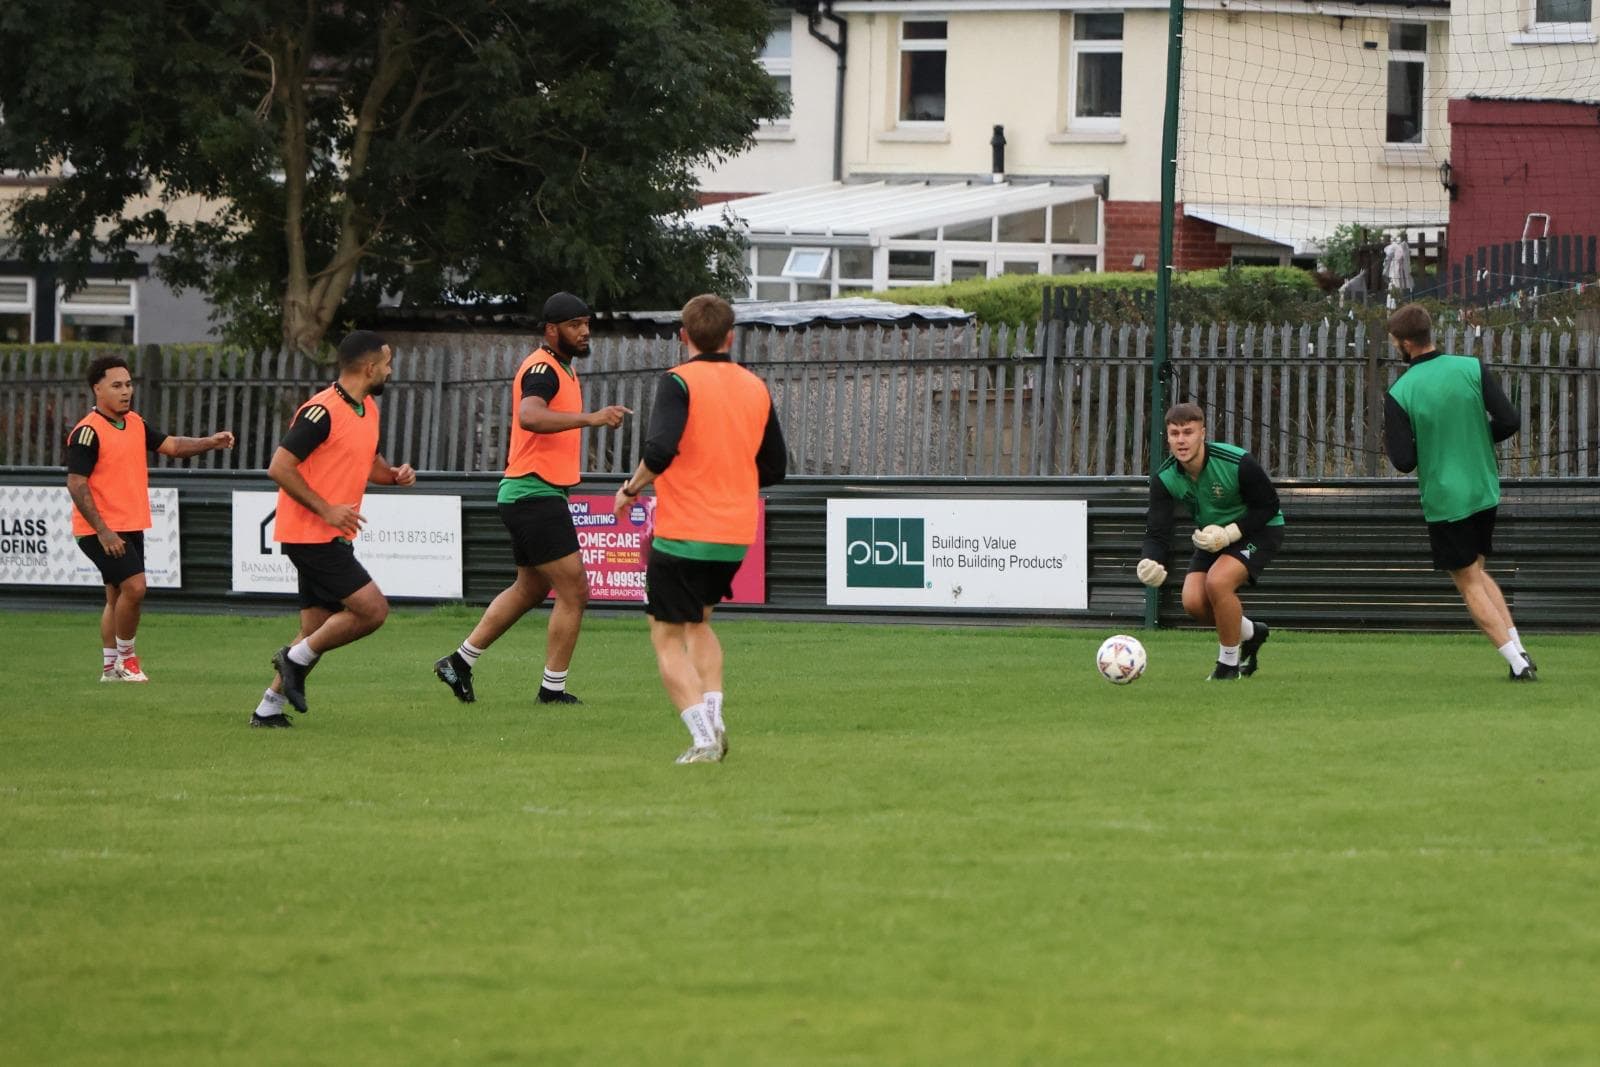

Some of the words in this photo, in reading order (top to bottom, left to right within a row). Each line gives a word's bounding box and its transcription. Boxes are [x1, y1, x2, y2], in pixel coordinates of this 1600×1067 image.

[378, 530, 404, 543] 0113
[407, 531, 427, 543] 873
[429, 531, 455, 544] 0541
[932, 535, 979, 552] Building
[983, 536, 1017, 550] Value
[847, 540, 925, 566] ODL
[241, 561, 283, 574] BANANA
[932, 555, 954, 568] Into
[958, 554, 1006, 571] Building
[606, 571, 647, 588] 499935
[591, 588, 609, 597] CARE
